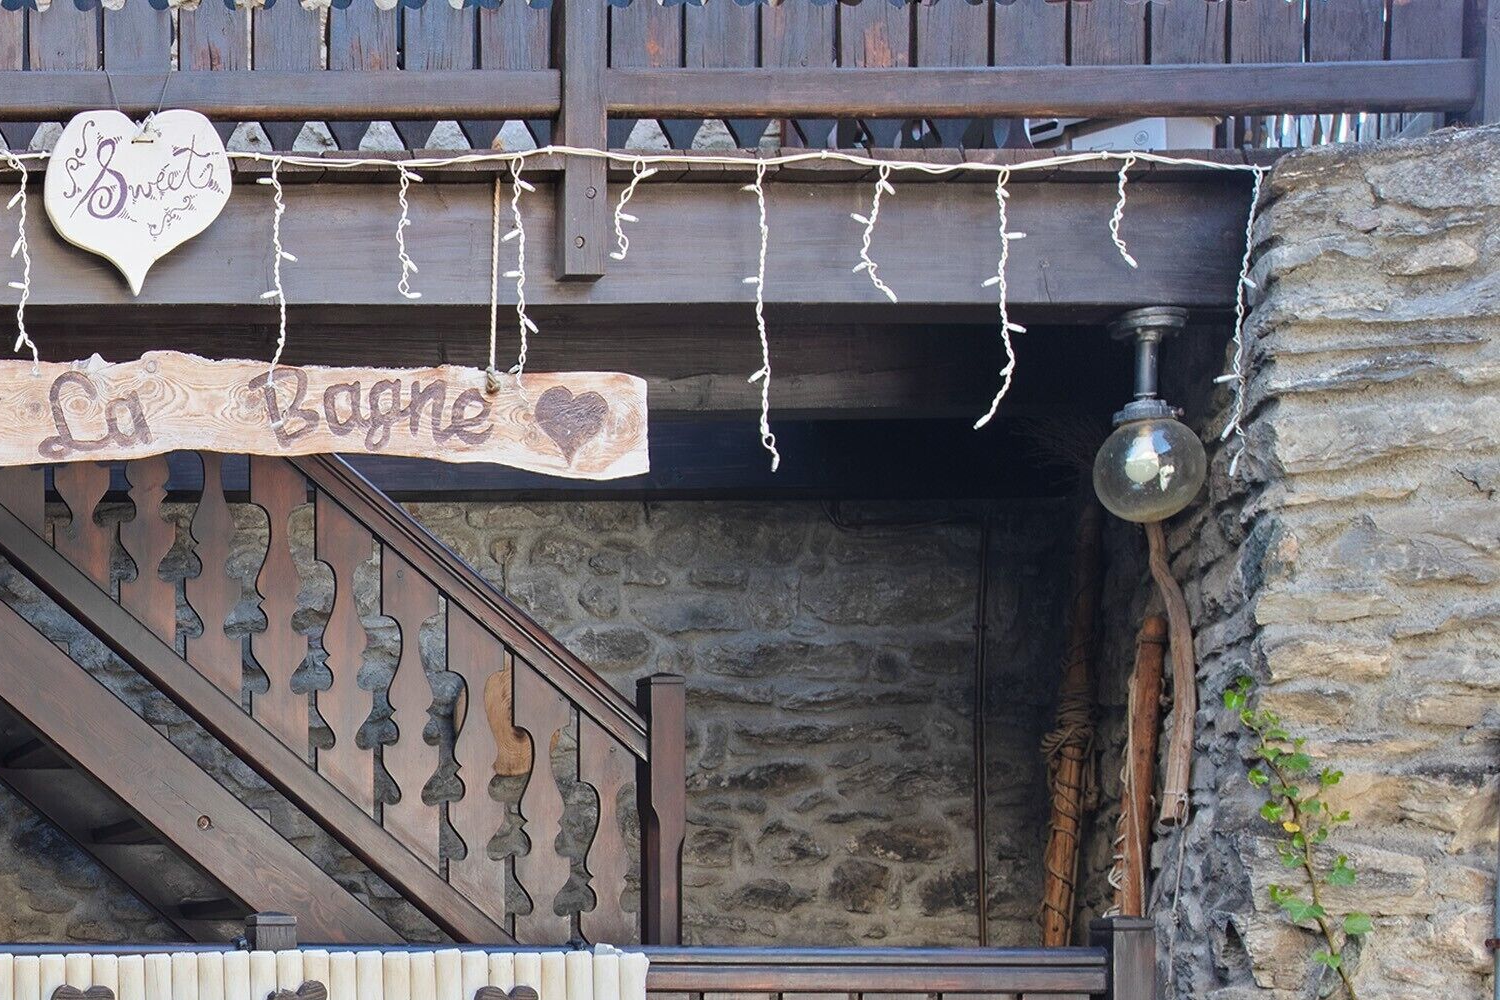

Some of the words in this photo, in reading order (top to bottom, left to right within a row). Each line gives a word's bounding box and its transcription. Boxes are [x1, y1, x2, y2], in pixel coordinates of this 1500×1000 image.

[70, 134, 215, 220] Sweet
[37, 370, 152, 459] La
[248, 367, 494, 451] Bagne
